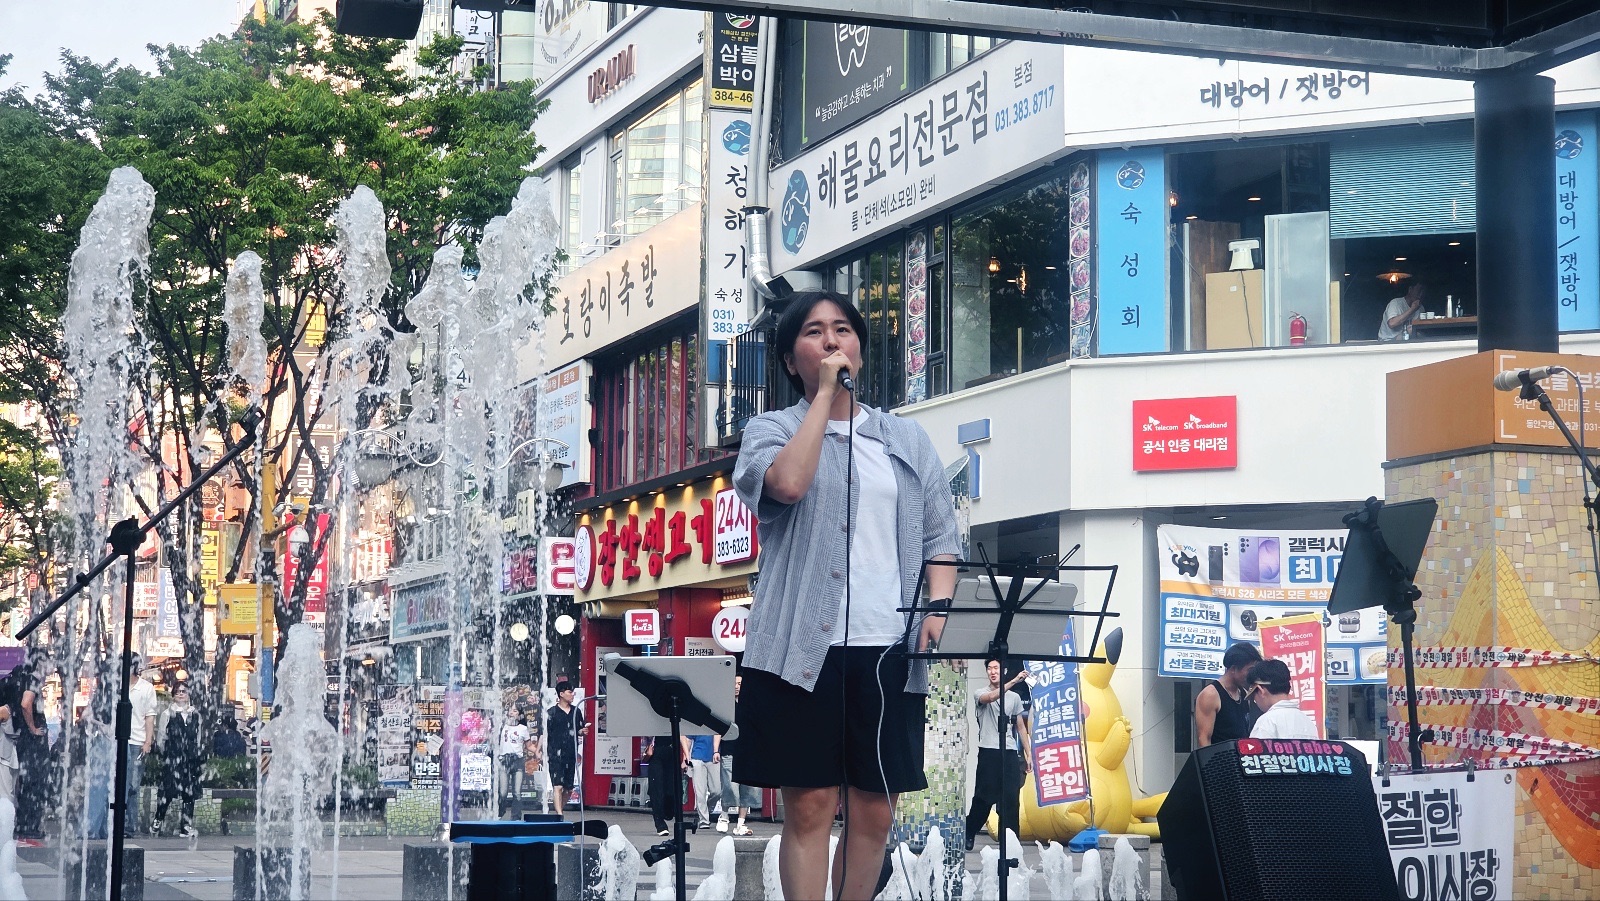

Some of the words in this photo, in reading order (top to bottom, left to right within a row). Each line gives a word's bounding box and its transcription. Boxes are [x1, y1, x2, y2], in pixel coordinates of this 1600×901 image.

[1013, 59, 1033, 88] 본점
[1200, 77, 1270, 108] 대방어
[1296, 70, 1370, 103] 잿방어
[817, 70, 988, 210] 해물요리전문점
[919, 174, 936, 202] 완비
[560, 244, 658, 346] 호랑이족발
[712, 309, 735, 320] 031)
[1183, 422, 1194, 430] SK
[1195, 421, 1228, 430] broadband
[1526, 419, 1555, 430] 동안구청
[1142, 440, 1165, 454] 공식
[1167, 438, 1191, 453] 인증
[1193, 437, 1228, 452] 대리점
[717, 536, 750, 558] 383-6323
[1288, 536, 1346, 553] 갤럭시
[1237, 588, 1255, 599] S26
[1258, 590, 1285, 600] 시리즈
[1287, 590, 1306, 600] 모든
[1309, 590, 1328, 600] 색상
[1170, 607, 1221, 622] 최대지원
[1169, 632, 1221, 647] 보상교체
[1273, 633, 1284, 643] SK
[1287, 631, 1314, 642] telecom
[1168, 658, 1220, 672] 선물증정
[1422, 652, 1435, 662] 안전
[1441, 652, 1453, 662] 제일
[1481, 651, 1495, 663] 안전
[1506, 652, 1526, 663] 제일
[1039, 668, 1066, 688] 이동
[1056, 686, 1077, 704] LG
[1394, 690, 1406, 701] 안전
[1449, 689, 1464, 700] 안전
[1469, 689, 1482, 699] 제일
[1524, 691, 1544, 703] 안전
[1553, 695, 1574, 707] 제일
[1038, 704, 1076, 727] 알뜰폰
[1034, 721, 1080, 744] 고객님!
[1441, 730, 1453, 742] 제일
[1481, 734, 1495, 746] 안전
[1505, 737, 1525, 748] 제일
[1038, 744, 1081, 773] 추가
[415, 762, 441, 776] 만원
[1040, 770, 1085, 799] 할인
[1380, 788, 1461, 849] 절한
